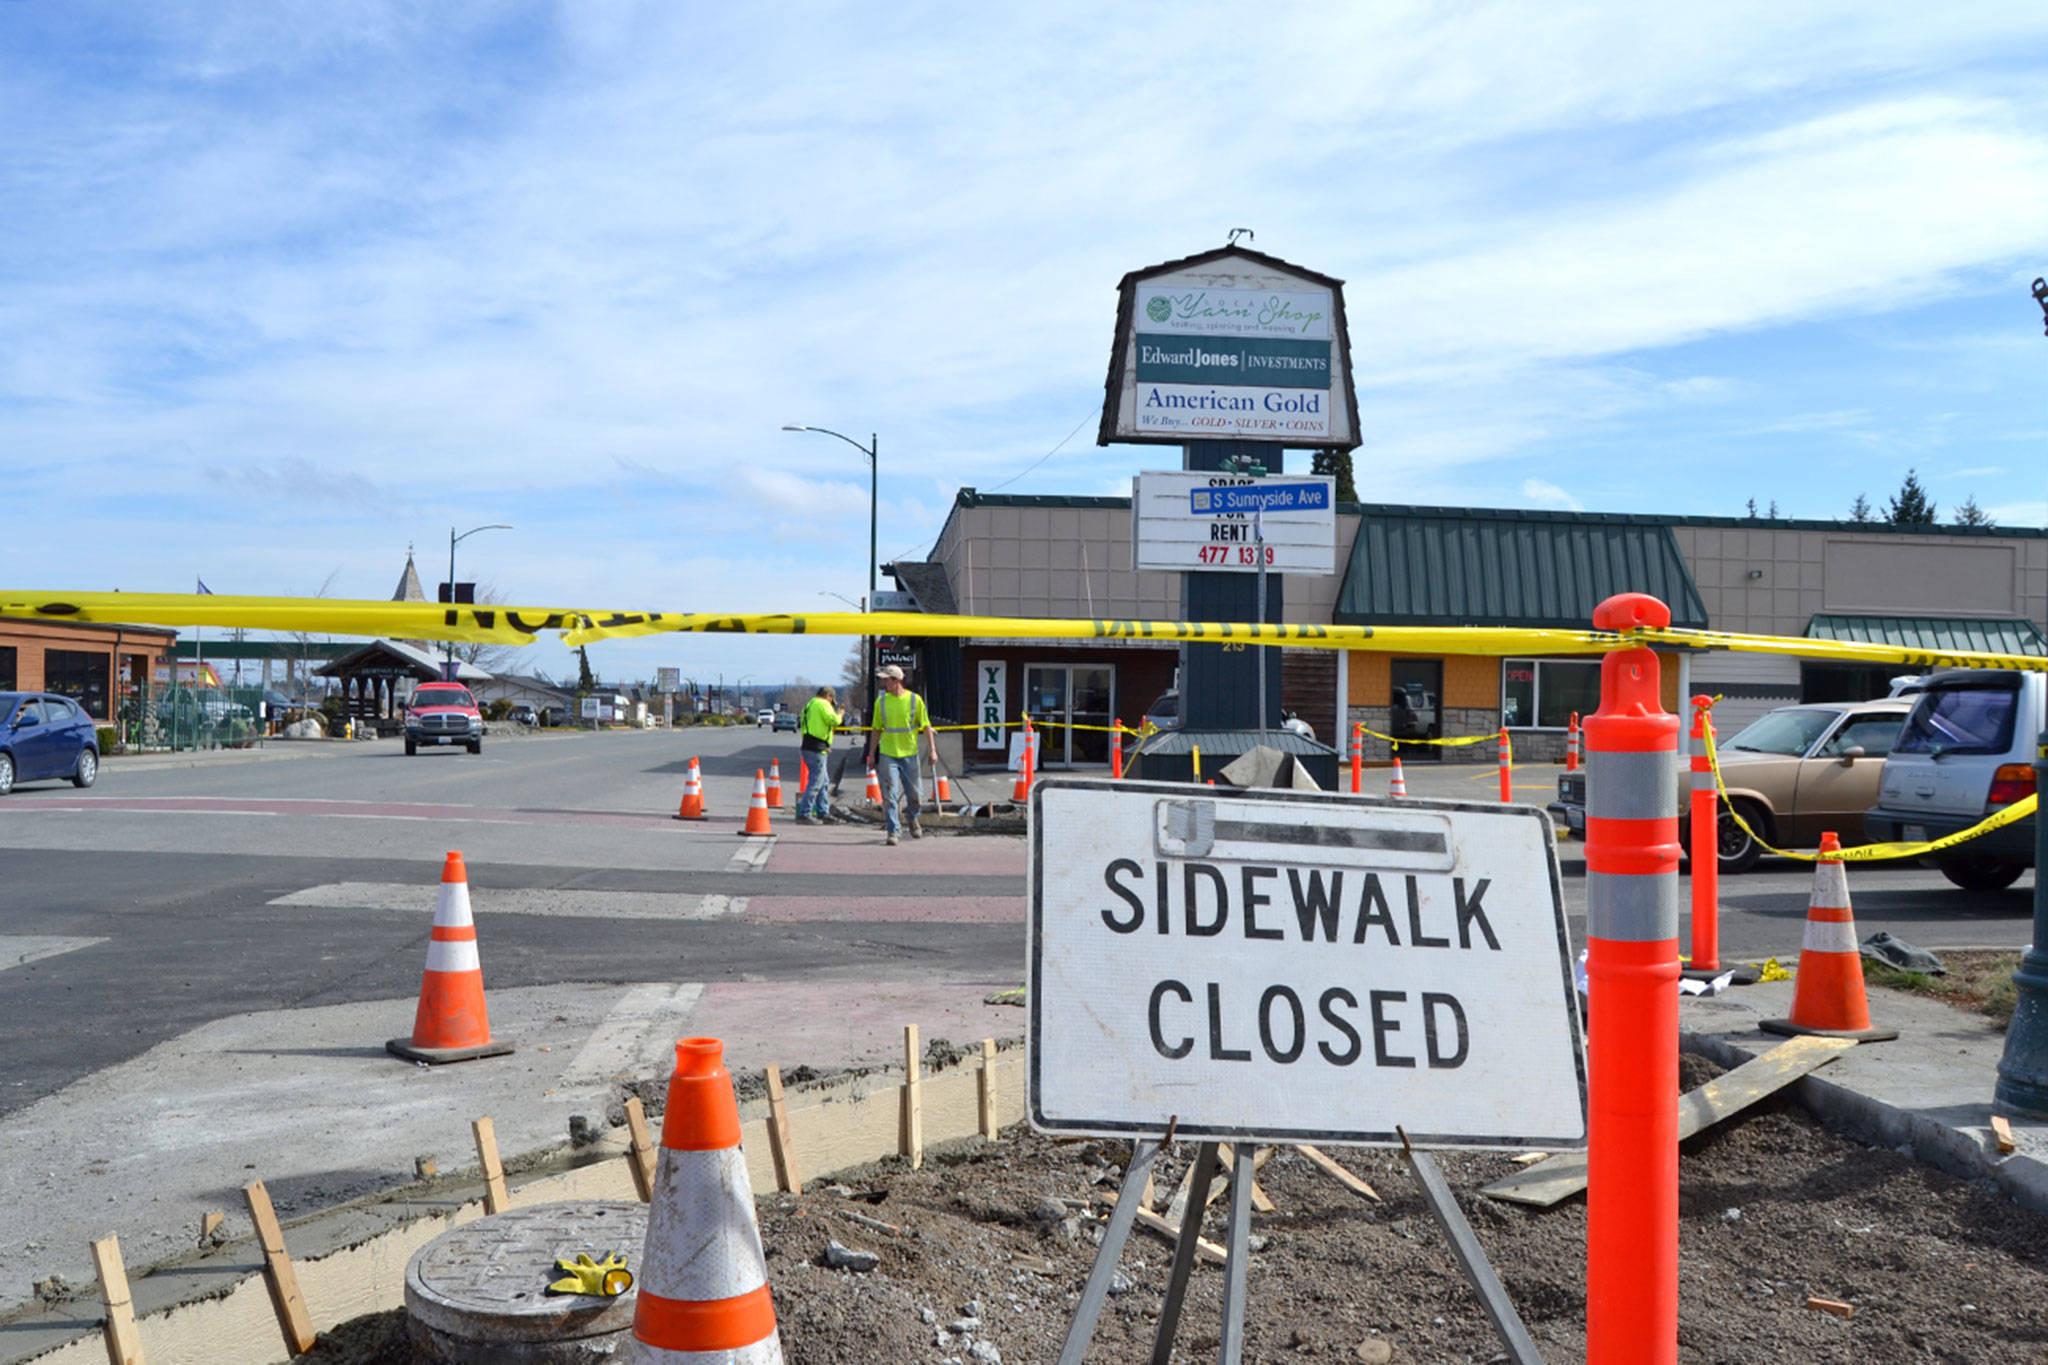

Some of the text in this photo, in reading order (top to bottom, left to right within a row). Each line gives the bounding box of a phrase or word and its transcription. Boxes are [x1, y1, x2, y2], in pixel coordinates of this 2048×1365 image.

[1171, 292, 1322, 333] Yarn Shop
[1248, 356, 1327, 370] INVESTMENTS
[1145, 388, 1320, 413] American Gold
[1141, 414, 1158, 426] We
[1191, 416, 1227, 428] GOLD
[1234, 417, 1277, 429] SILVER
[1285, 419, 1325, 431] COINS
[1213, 489, 1322, 510] S Sunnyside Ave
[1210, 524, 1249, 541] RENT
[1198, 546, 1229, 564] 477
[1223, 641, 1245, 652] 213
[1506, 669, 1535, 682] OPEN
[983, 666, 1001, 743] YARN
[1100, 857, 1503, 951] SIDEWALK
[1147, 978, 1470, 1070] CLOSED
